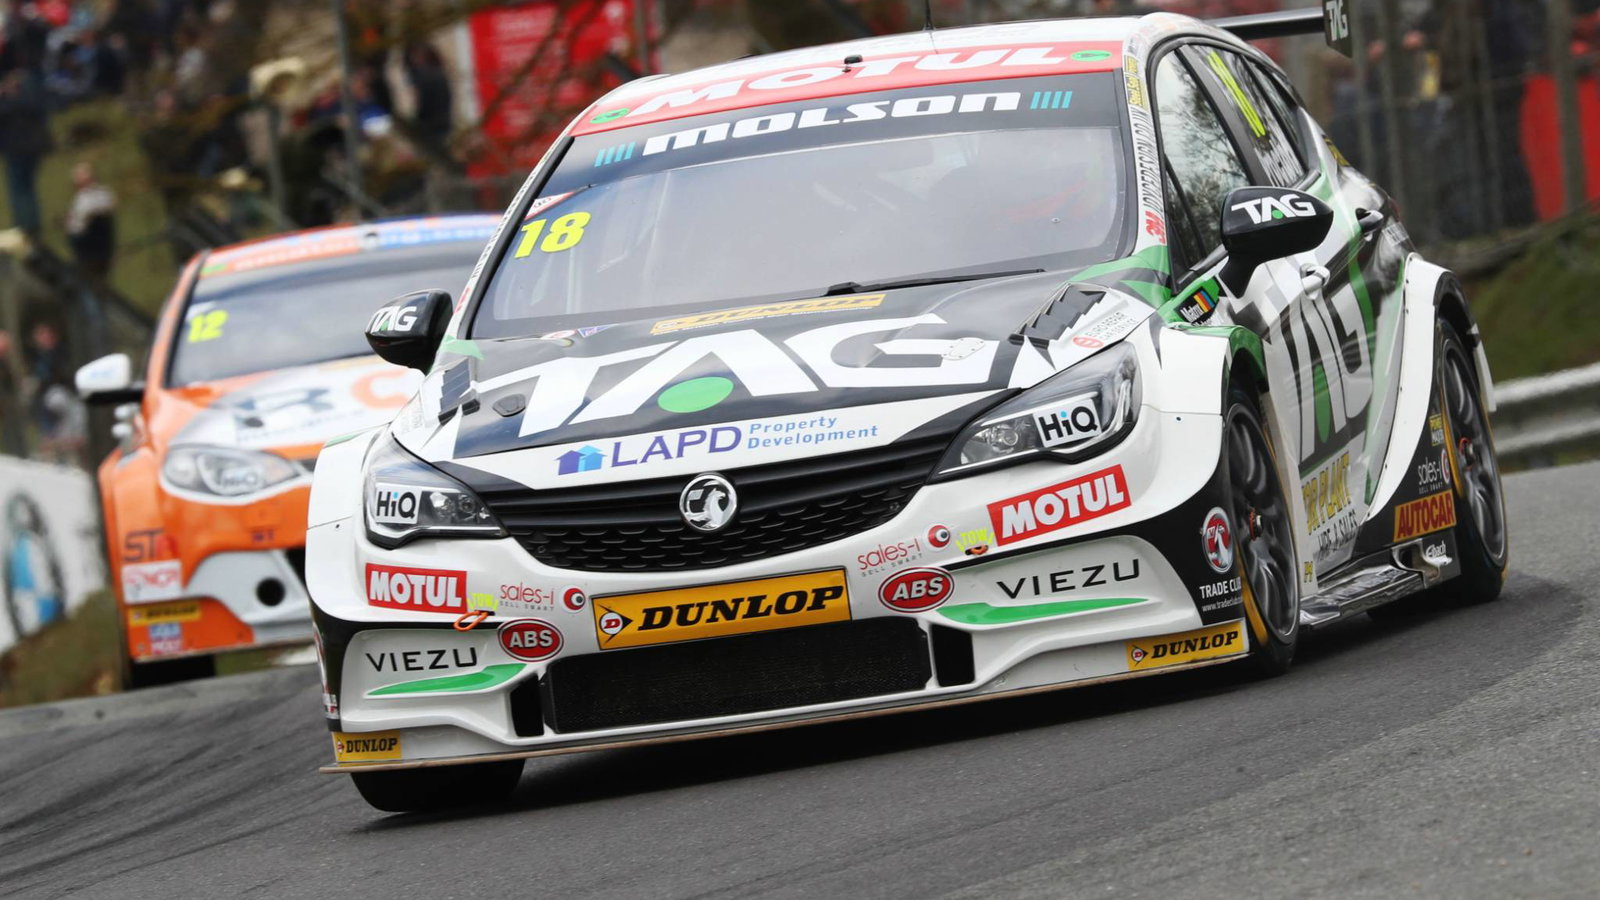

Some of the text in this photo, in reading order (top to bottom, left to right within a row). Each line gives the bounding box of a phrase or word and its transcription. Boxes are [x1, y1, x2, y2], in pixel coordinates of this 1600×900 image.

[629, 46, 1070, 117] MOTUL
[1231, 194, 1316, 225] TAG
[515, 211, 591, 258] 18
[187, 310, 229, 343] 12
[366, 305, 417, 334] TAG
[476, 313, 1000, 438] TAG
[747, 424, 878, 451] Development
[749, 414, 838, 435] Property
[1038, 406, 1098, 442] HiQ
[611, 426, 742, 467] LAPD
[376, 491, 416, 519] HiQ
[1001, 473, 1125, 540] MOTUL
[1397, 492, 1455, 539] AUTOCAR
[962, 528, 989, 547] TOW
[369, 570, 463, 608] MOTUL
[892, 575, 944, 601] ABS
[996, 558, 1141, 599] VIEZU
[1199, 580, 1229, 599] TRADE
[637, 585, 844, 631] DUNLOP
[509, 629, 554, 648] ABS
[1151, 630, 1239, 659] DUNLOP
[366, 647, 478, 672] VIEZU
[346, 738, 398, 753] DUNLOP
